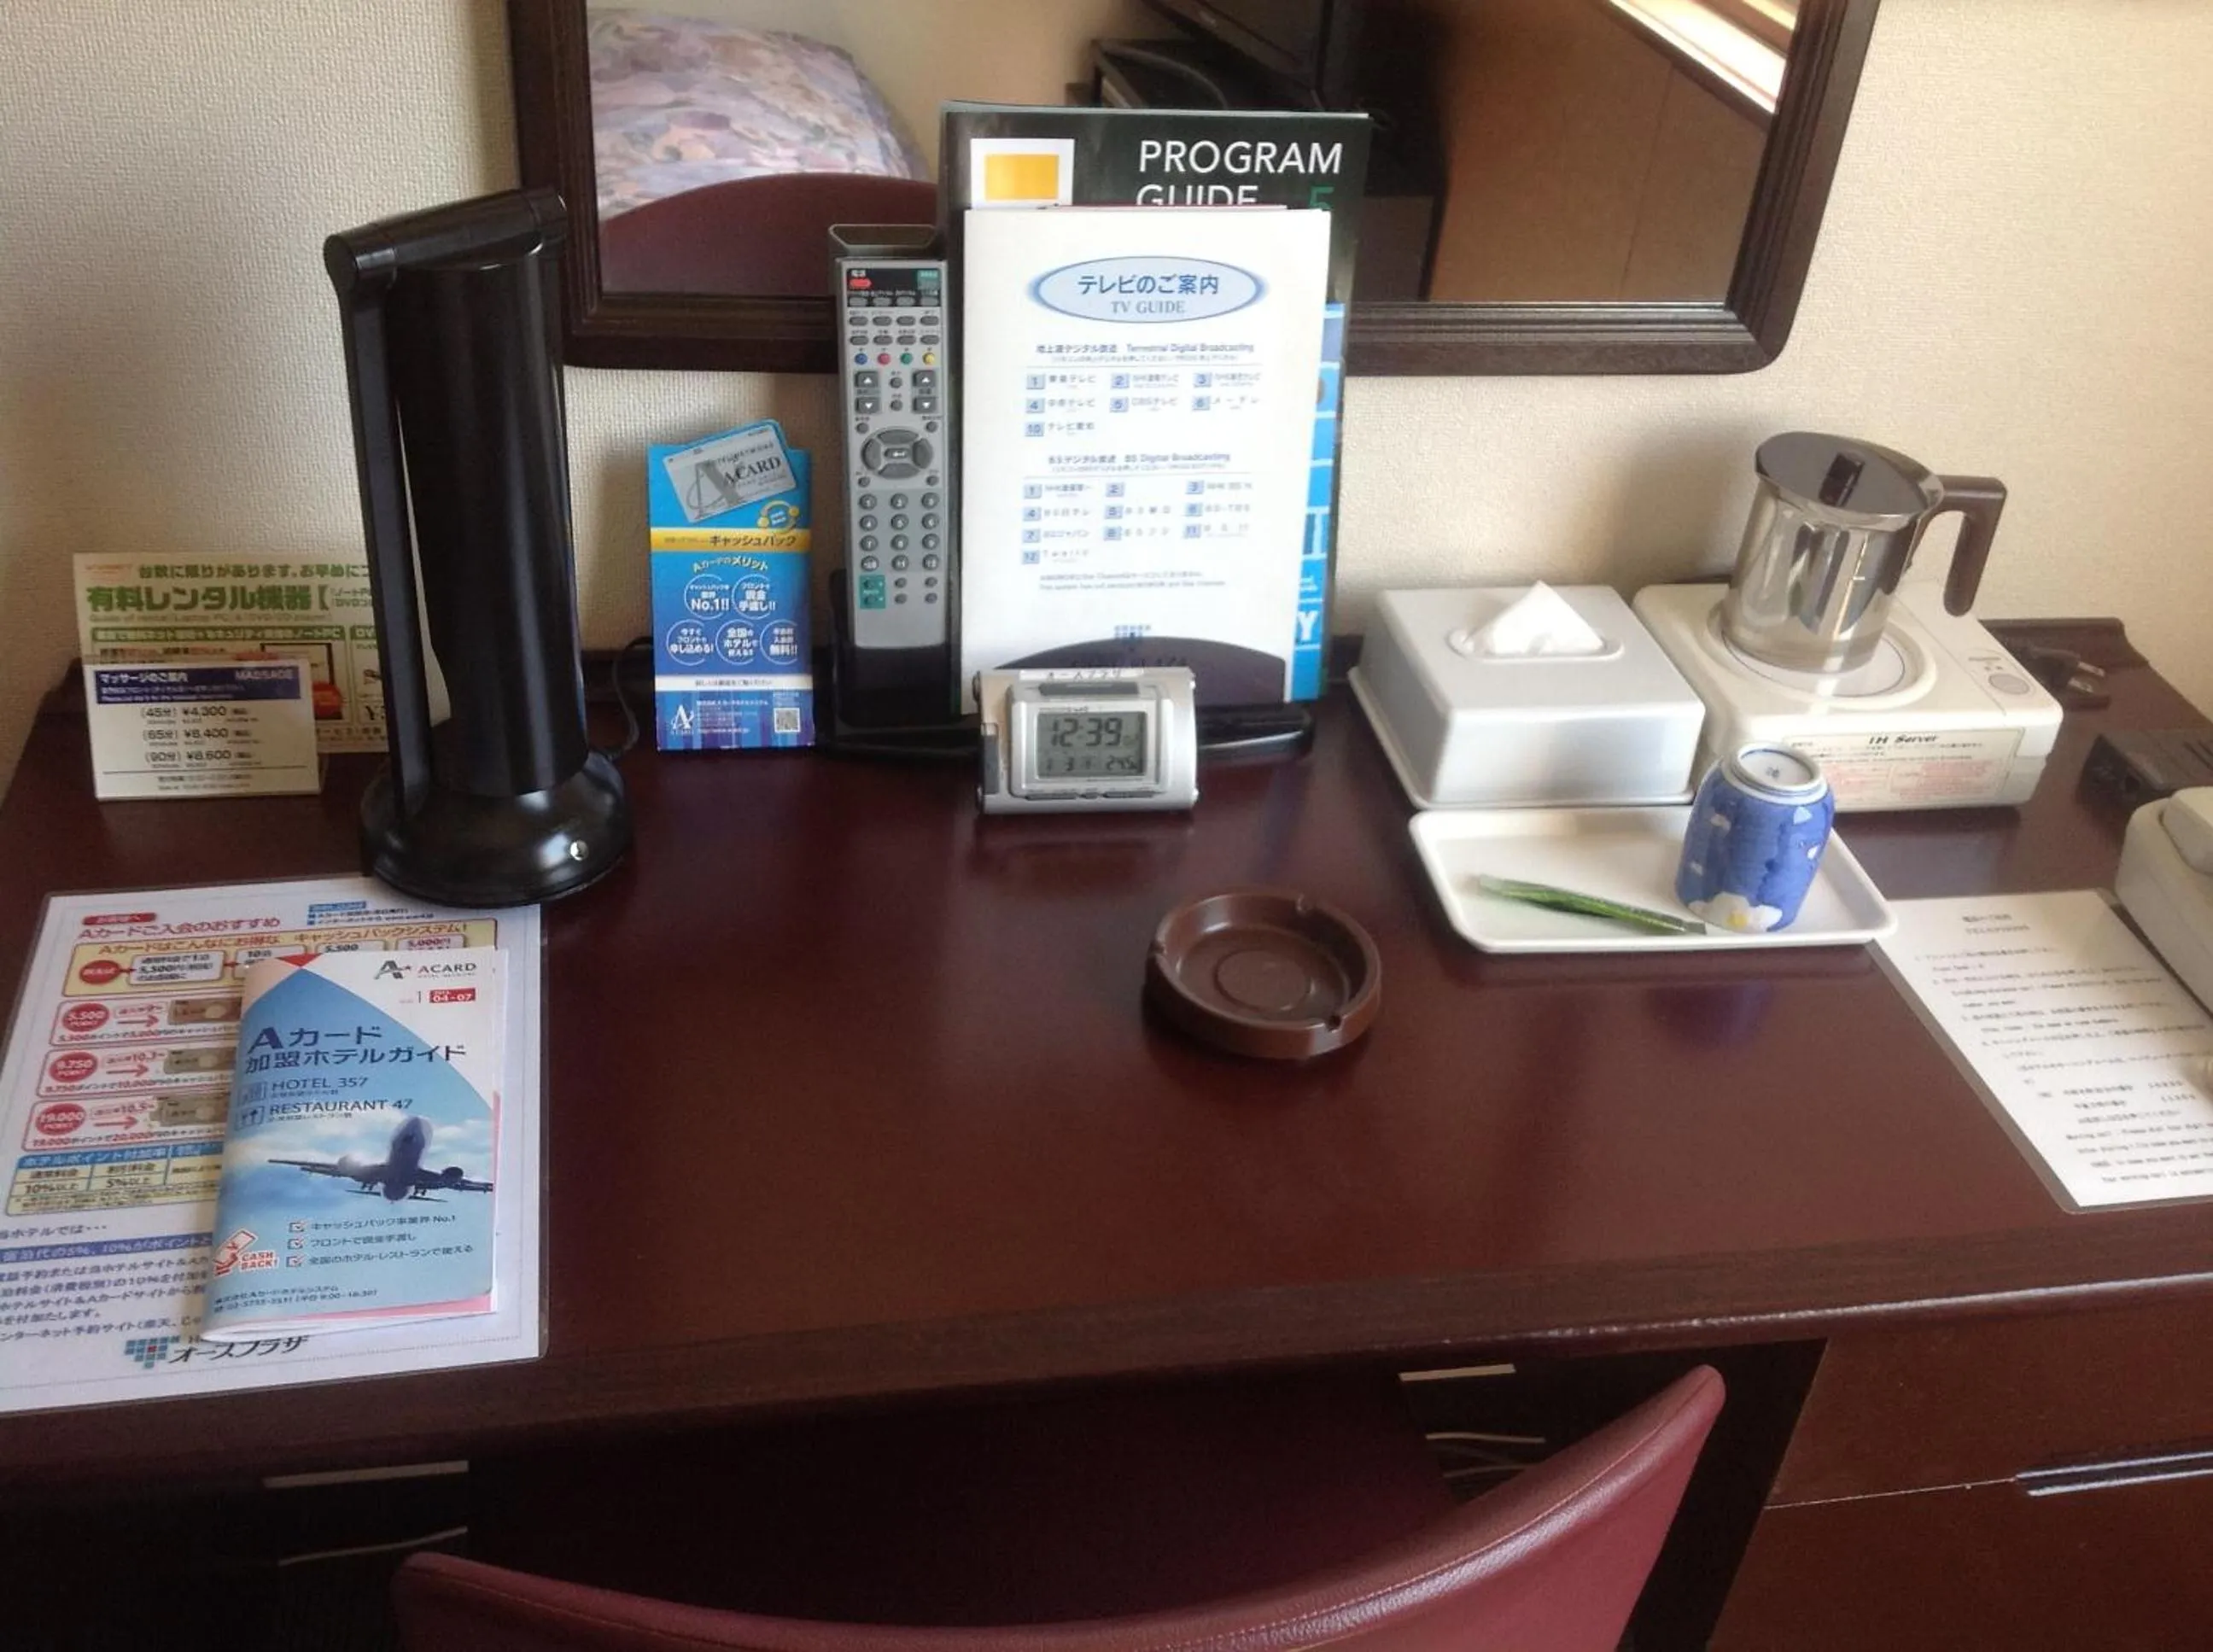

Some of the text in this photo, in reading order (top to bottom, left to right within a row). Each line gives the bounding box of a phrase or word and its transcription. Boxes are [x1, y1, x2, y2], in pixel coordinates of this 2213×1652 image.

[1140, 139, 1344, 175] PROGRAM
[1136, 184, 1258, 206] GUIDE
[1077, 273, 1219, 296] テレビのご案内
[1111, 301, 1186, 314] TV GUIDE
[709, 534, 797, 547] キャッシュバック
[235, 668, 295, 681] MASSAGE
[1050, 717, 1123, 748] 12:39
[79, 917, 281, 939] Aカードご入会のおすすめ
[294, 921, 468, 943] キャッシュバックシステム!
[417, 962, 477, 974] ACARD
[433, 992, 474, 1003] 04-07
[247, 1025, 382, 1054] Aカード
[244, 1044, 467, 1075] 加盟ホテルガイド
[272, 1077, 369, 1091] HOTEL 357
[269, 1098, 414, 1116] RESTAURANT 47
[433, 1214, 457, 1223] No.1
[241, 1252, 274, 1262] CASH
[241, 1260, 278, 1270] BACK!
